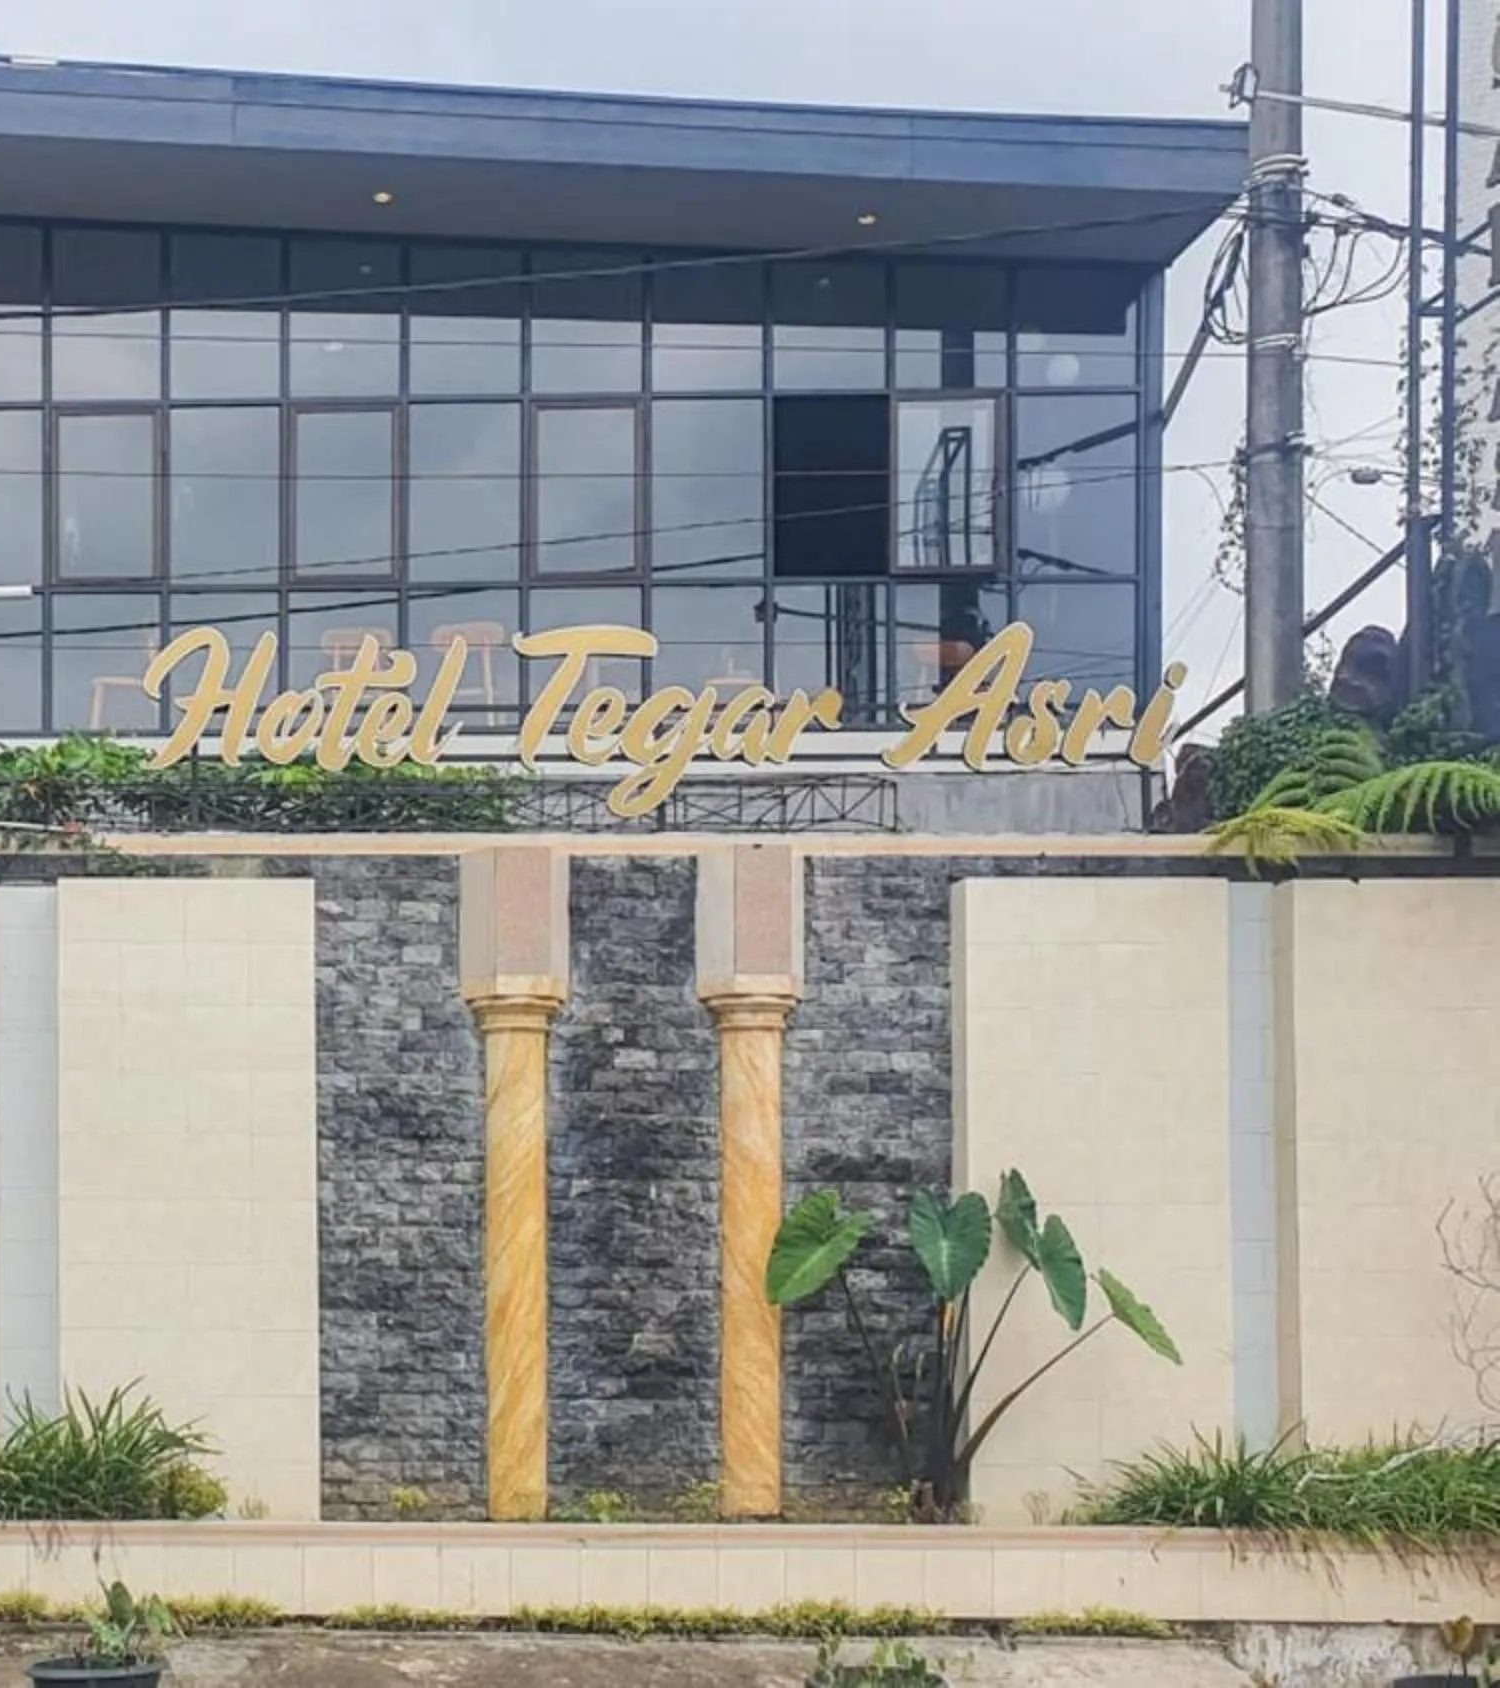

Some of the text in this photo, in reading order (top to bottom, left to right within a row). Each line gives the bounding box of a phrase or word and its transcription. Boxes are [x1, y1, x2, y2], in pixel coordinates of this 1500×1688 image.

[142, 620, 1189, 819] Hotel Tegar Asri
